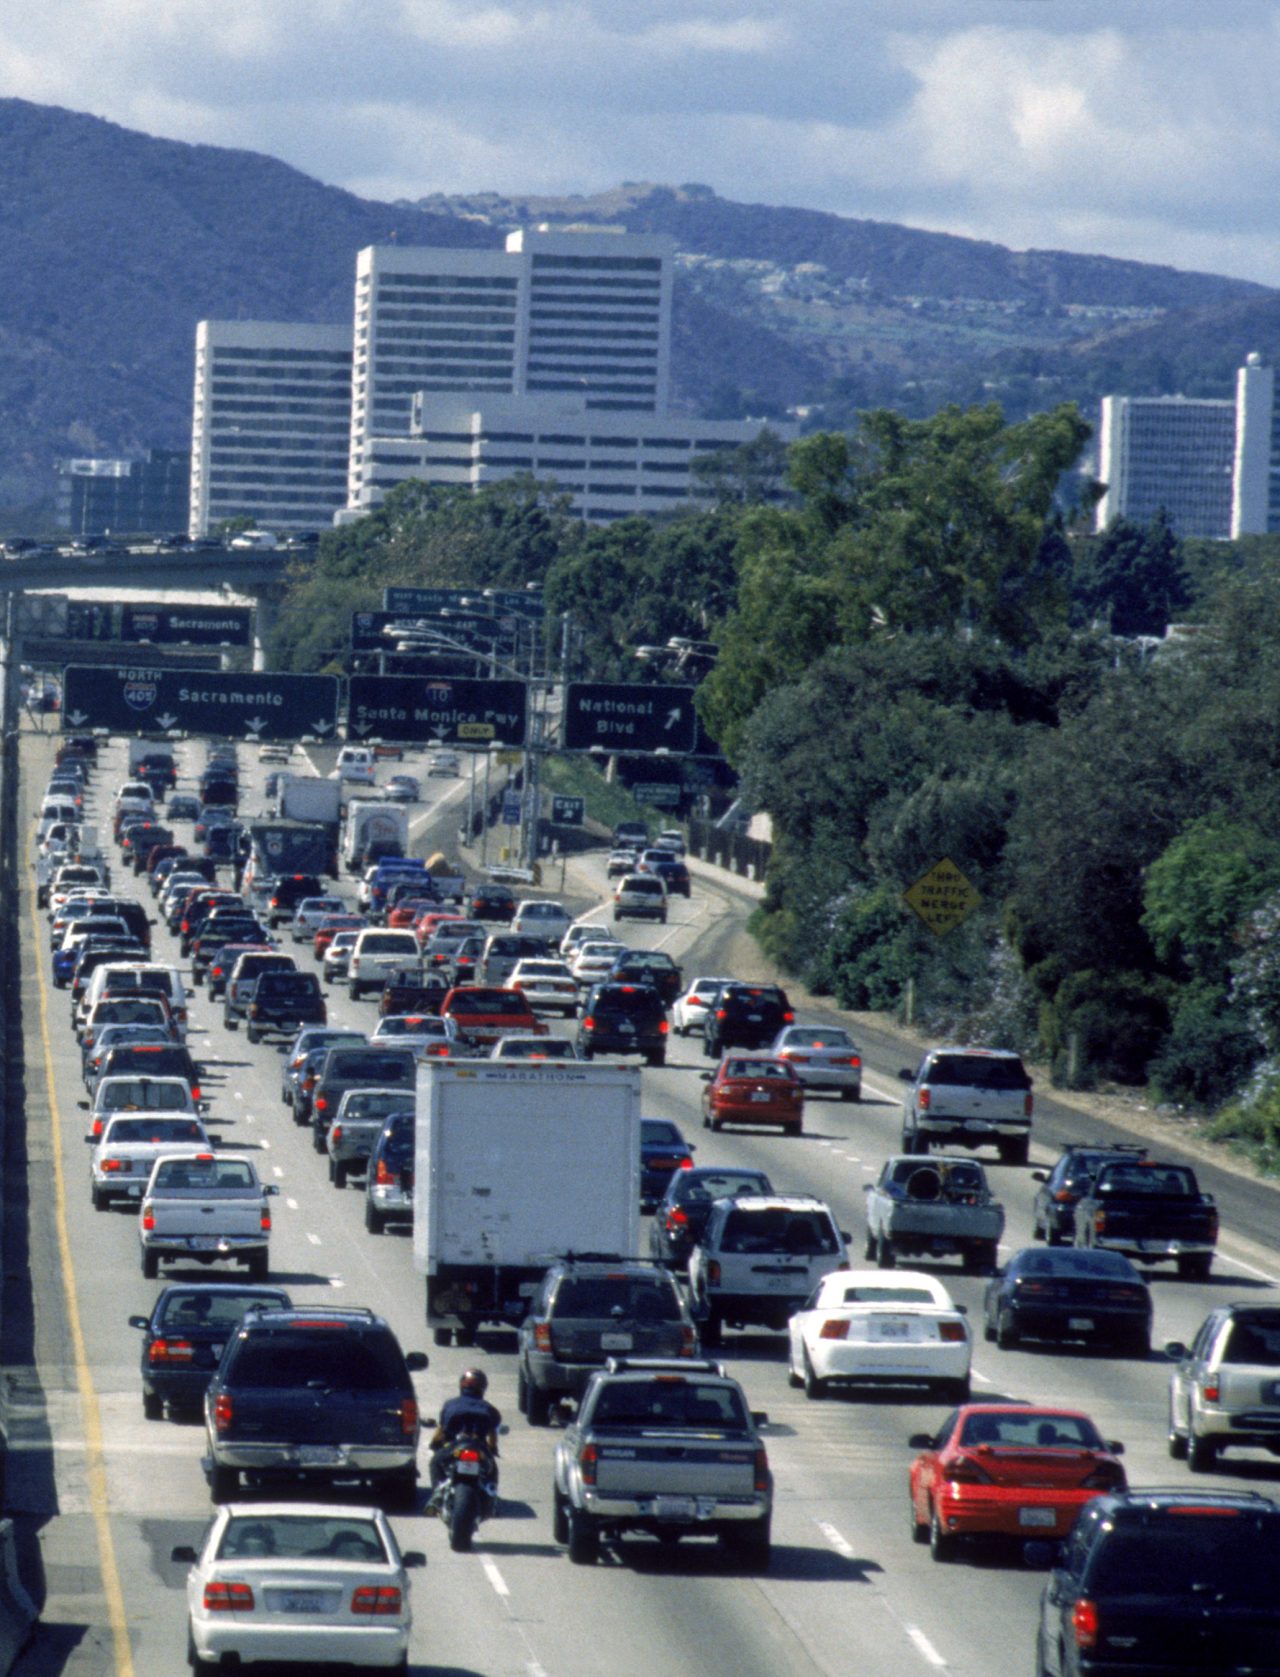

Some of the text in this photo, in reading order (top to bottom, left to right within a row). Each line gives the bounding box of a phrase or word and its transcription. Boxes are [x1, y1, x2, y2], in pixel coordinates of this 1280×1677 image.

[169, 616, 241, 631] Sacramento
[118, 670, 162, 680] NORTH
[128, 691, 152, 701] 405
[179, 688, 283, 706] Sacramento
[431, 690, 448, 702] 10
[579, 699, 653, 714] National
[357, 705, 519, 728] Santa Monica Fwy
[462, 726, 490, 735] ONLY
[596, 719, 635, 734] Blvd
[555, 799, 581, 810] EXIT
[921, 899, 966, 910] MERGE
[497, 1072, 576, 1081] MARATHON
